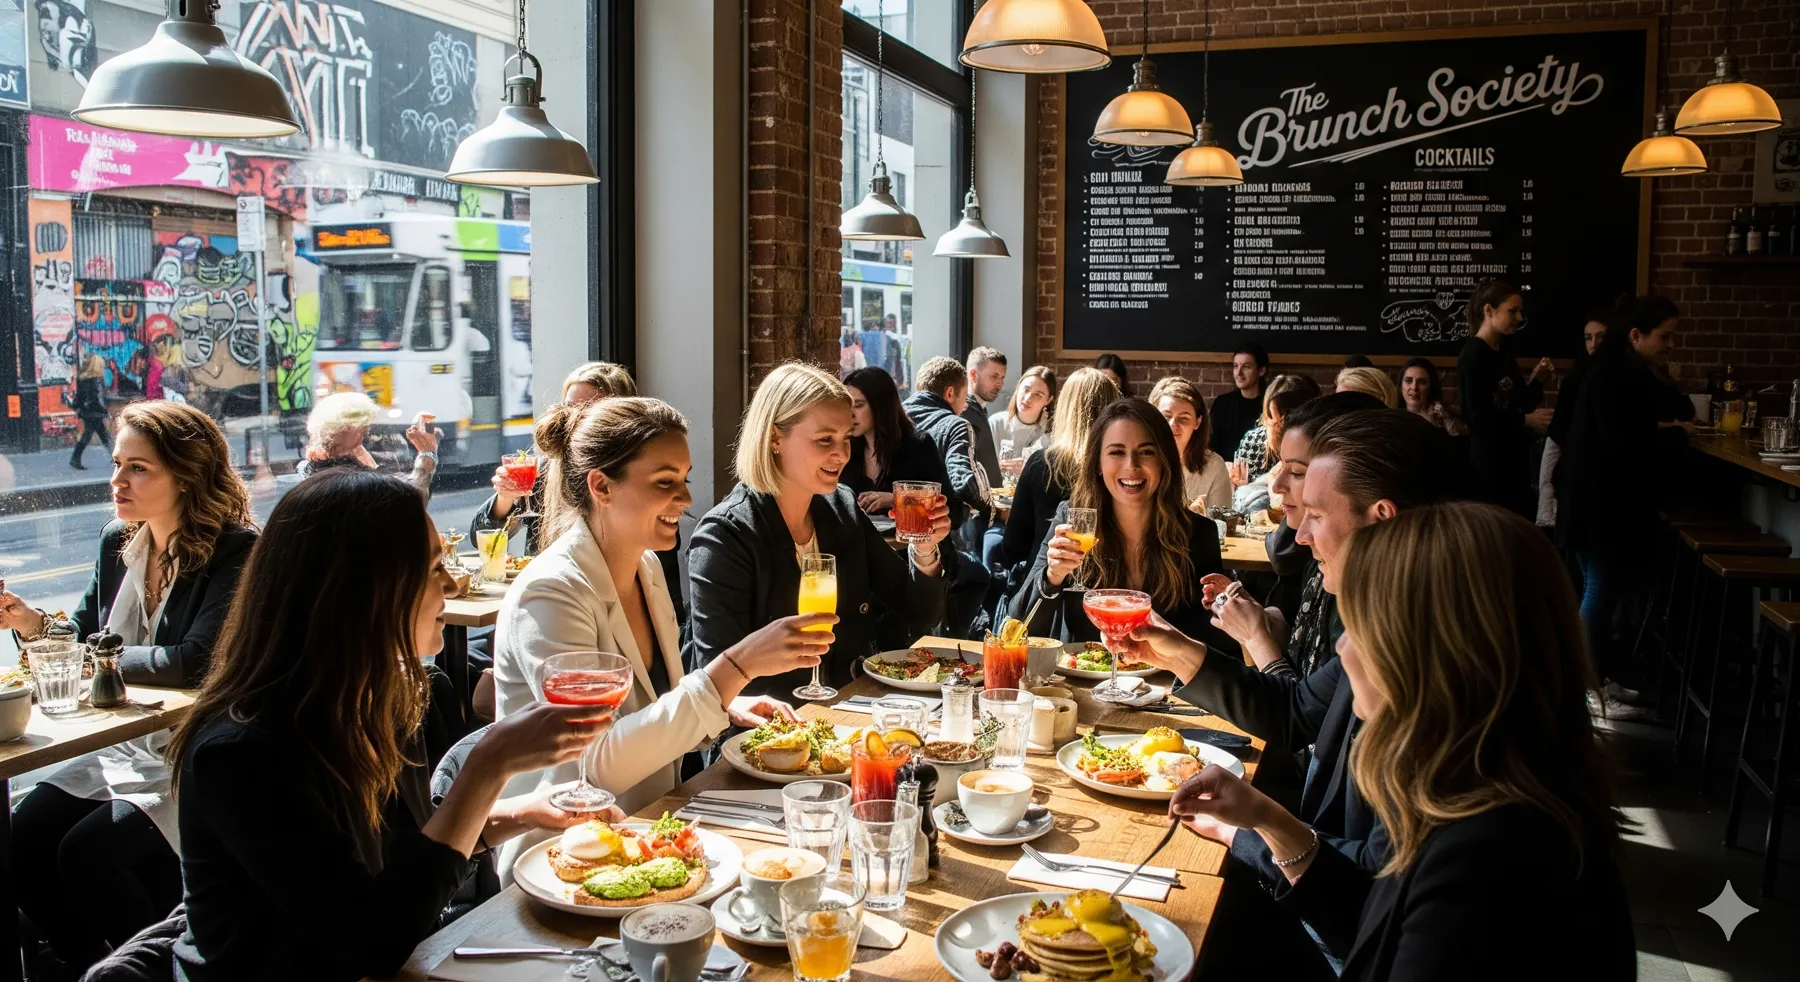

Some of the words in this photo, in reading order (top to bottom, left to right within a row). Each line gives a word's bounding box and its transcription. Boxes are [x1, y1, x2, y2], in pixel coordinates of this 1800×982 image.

[1236, 87, 1412, 170] Brunch
[1417, 55, 1604, 127] Society
[1280, 82, 1329, 117] The
[1415, 147, 1495, 167] COCKTAILS
